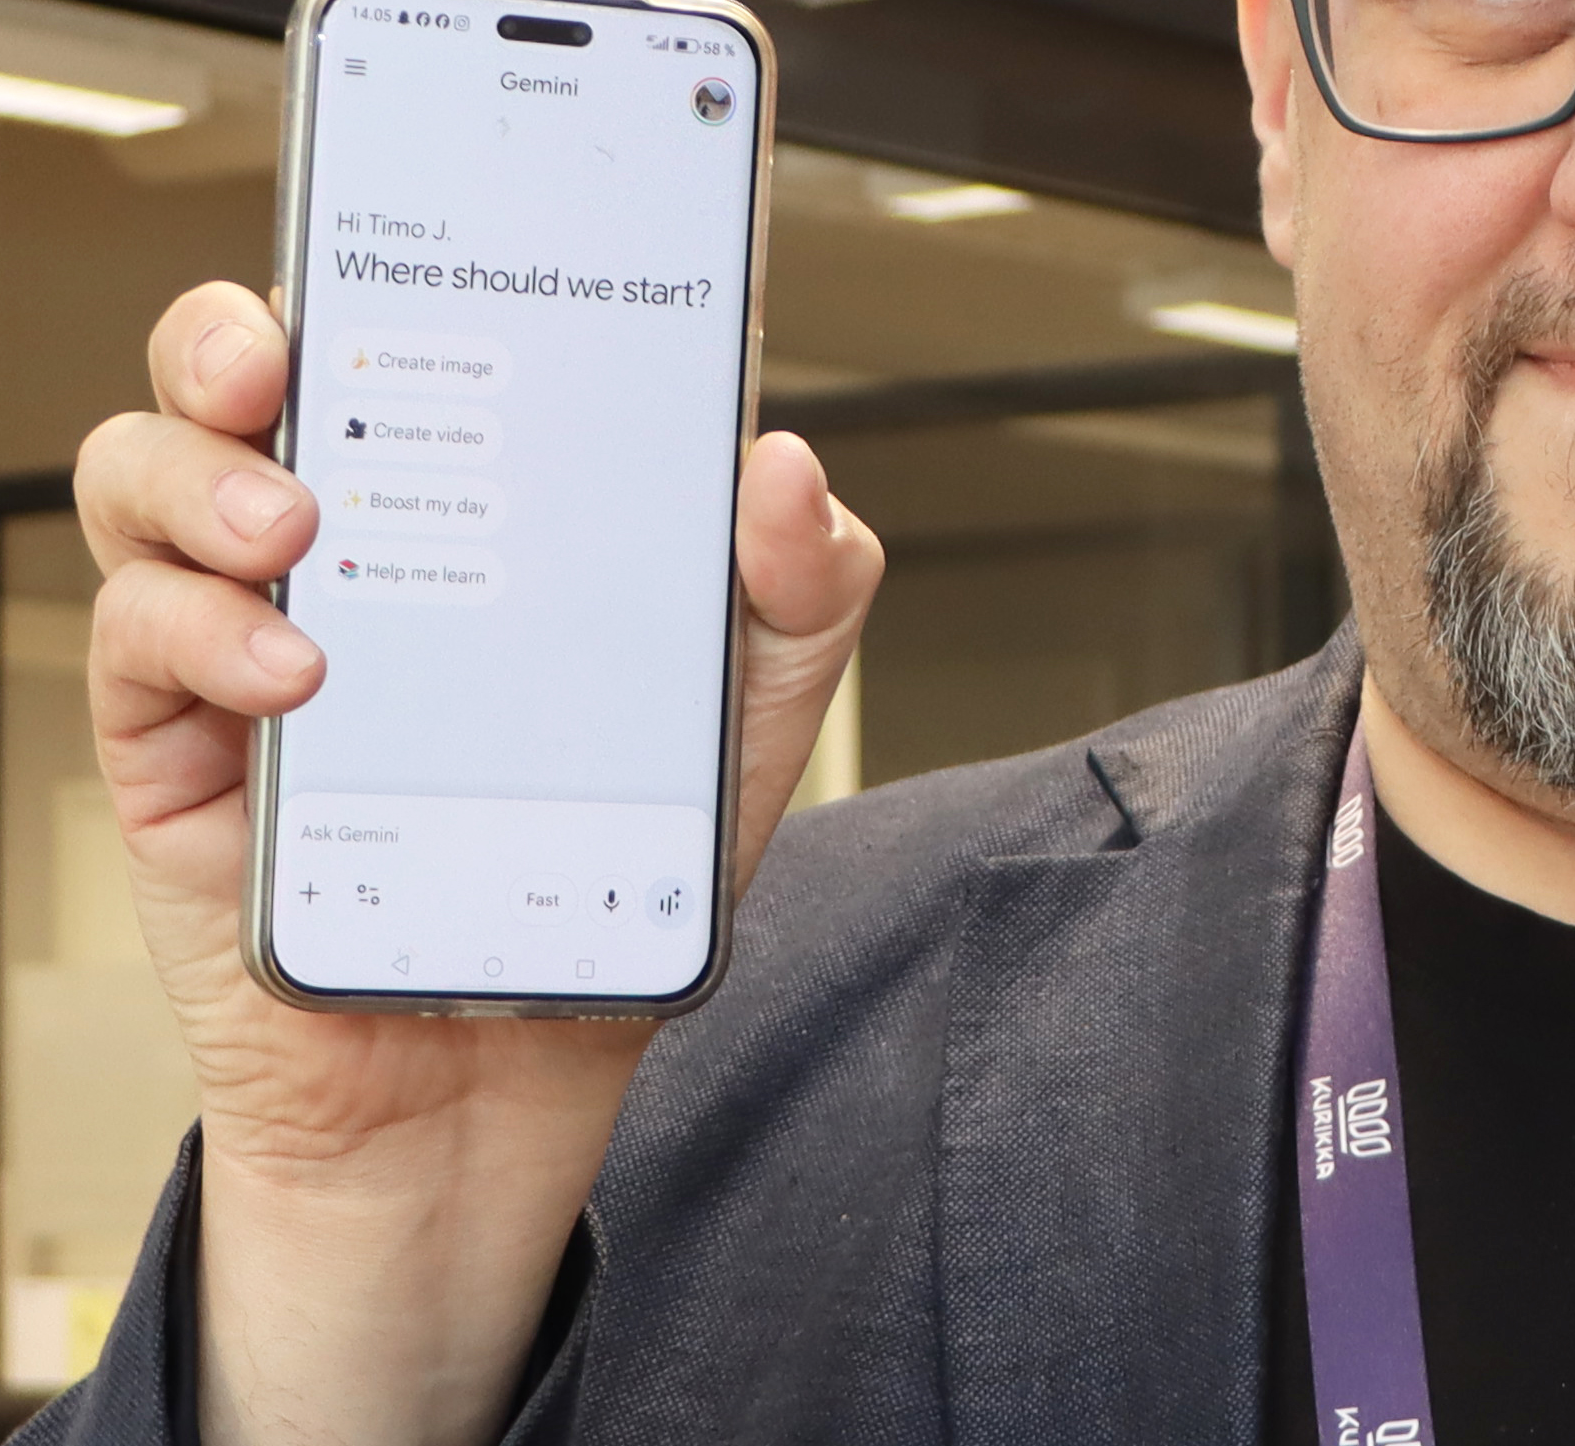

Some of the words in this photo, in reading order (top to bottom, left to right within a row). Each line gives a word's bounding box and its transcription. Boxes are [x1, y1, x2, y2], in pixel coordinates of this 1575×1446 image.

[352, 5, 393, 23] 14.05
[703, 42, 720, 56] 58
[499, 71, 579, 98] Gemini
[336, 211, 361, 234] Hi
[369, 213, 426, 239] Timo
[432, 219, 452, 241] J.
[335, 249, 444, 287] Where
[451, 261, 560, 297] should
[567, 273, 614, 301] we
[622, 276, 712, 308] start?
[377, 351, 437, 372] Create
[441, 355, 494, 379] image
[373, 421, 433, 442] Create
[437, 426, 485, 445] video
[370, 492, 421, 511] Boost
[425, 498, 453, 516] my
[456, 496, 489, 519] day
[366, 562, 407, 584] Help
[410, 568, 438, 582] me
[443, 565, 487, 584] learn
[300, 823, 333, 842] Ask
[338, 824, 400, 844] Gemini
[526, 891, 561, 908] Fast
[1309, 1075, 1336, 1181] KURIKKA
